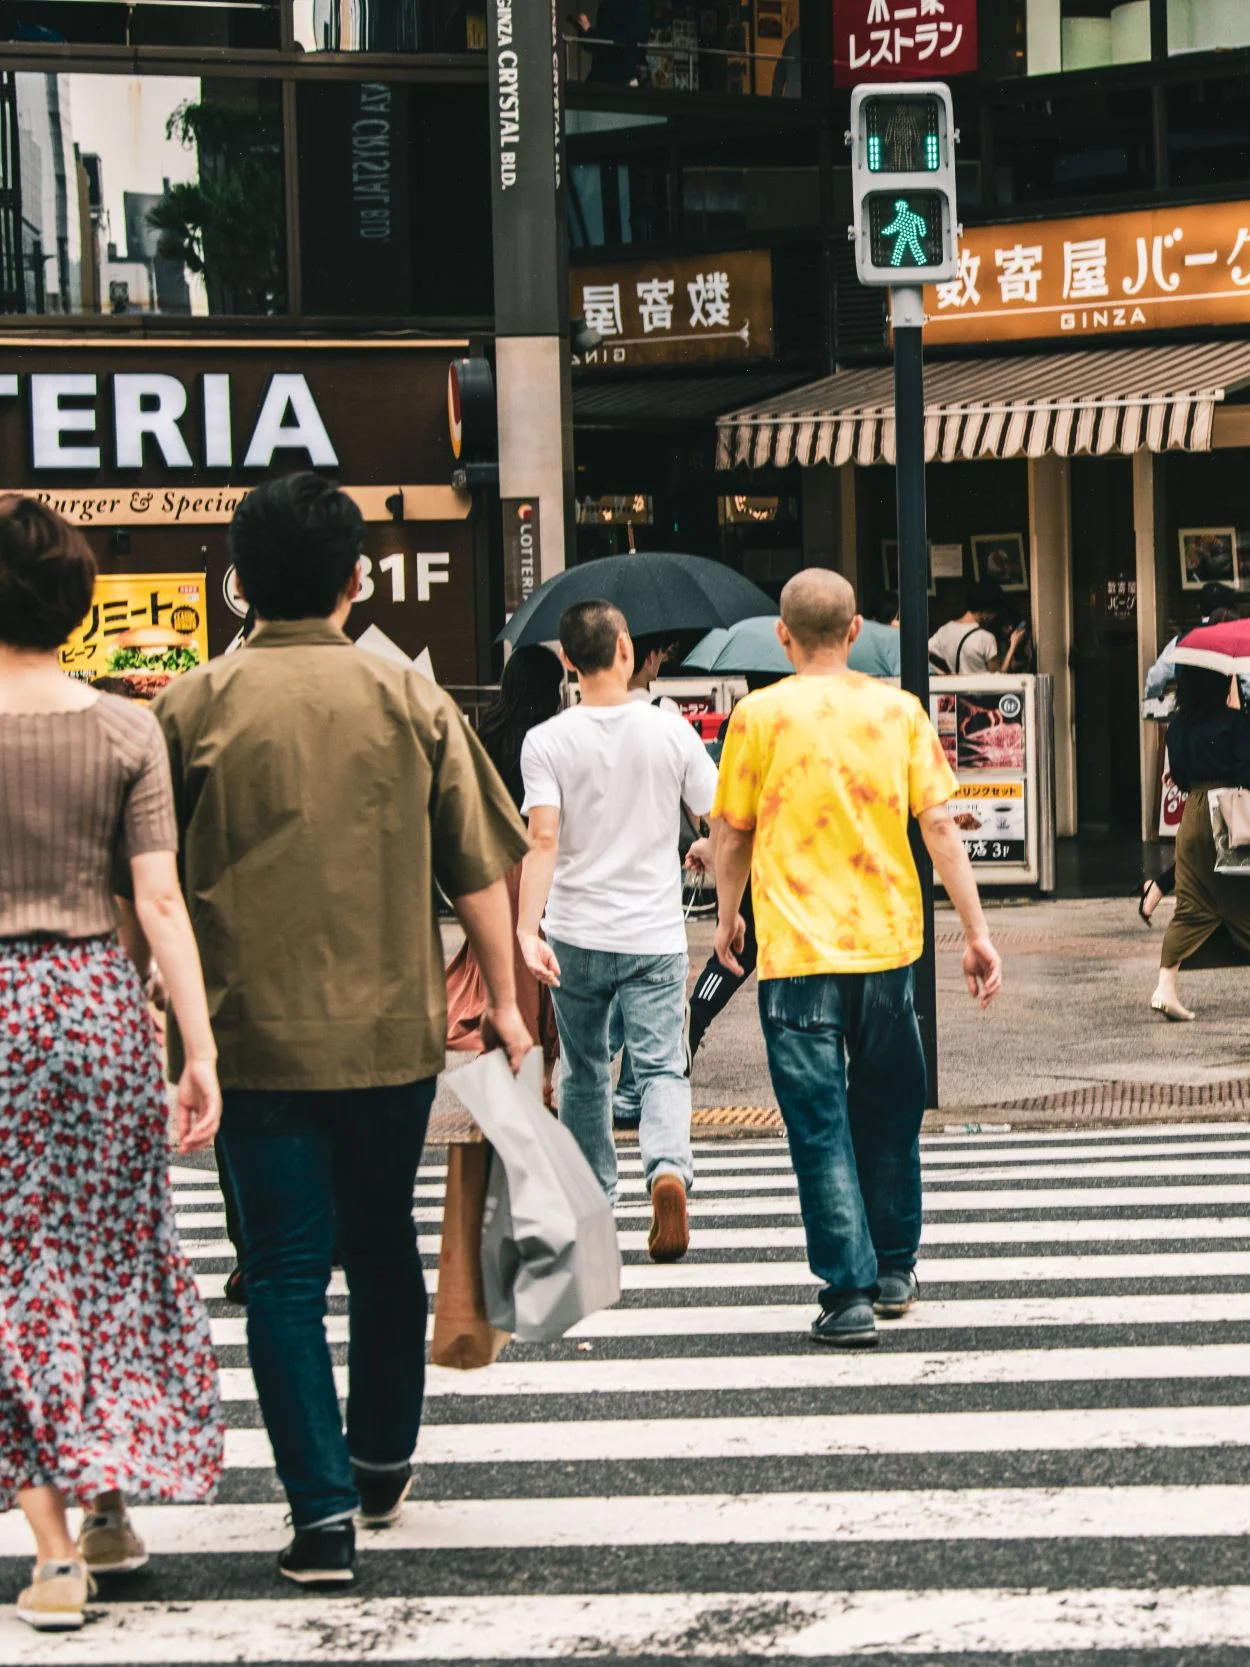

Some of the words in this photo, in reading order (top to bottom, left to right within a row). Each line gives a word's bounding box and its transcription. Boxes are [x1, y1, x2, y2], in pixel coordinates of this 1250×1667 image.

[849, 21, 963, 70] レストラン
[498, 50, 520, 148] CRYSTAL
[501, 152, 517, 190] BLD.
[1060, 307, 1146, 330] GINZA
[0, 373, 339, 468] ERIA
[129, 491, 154, 513] &
